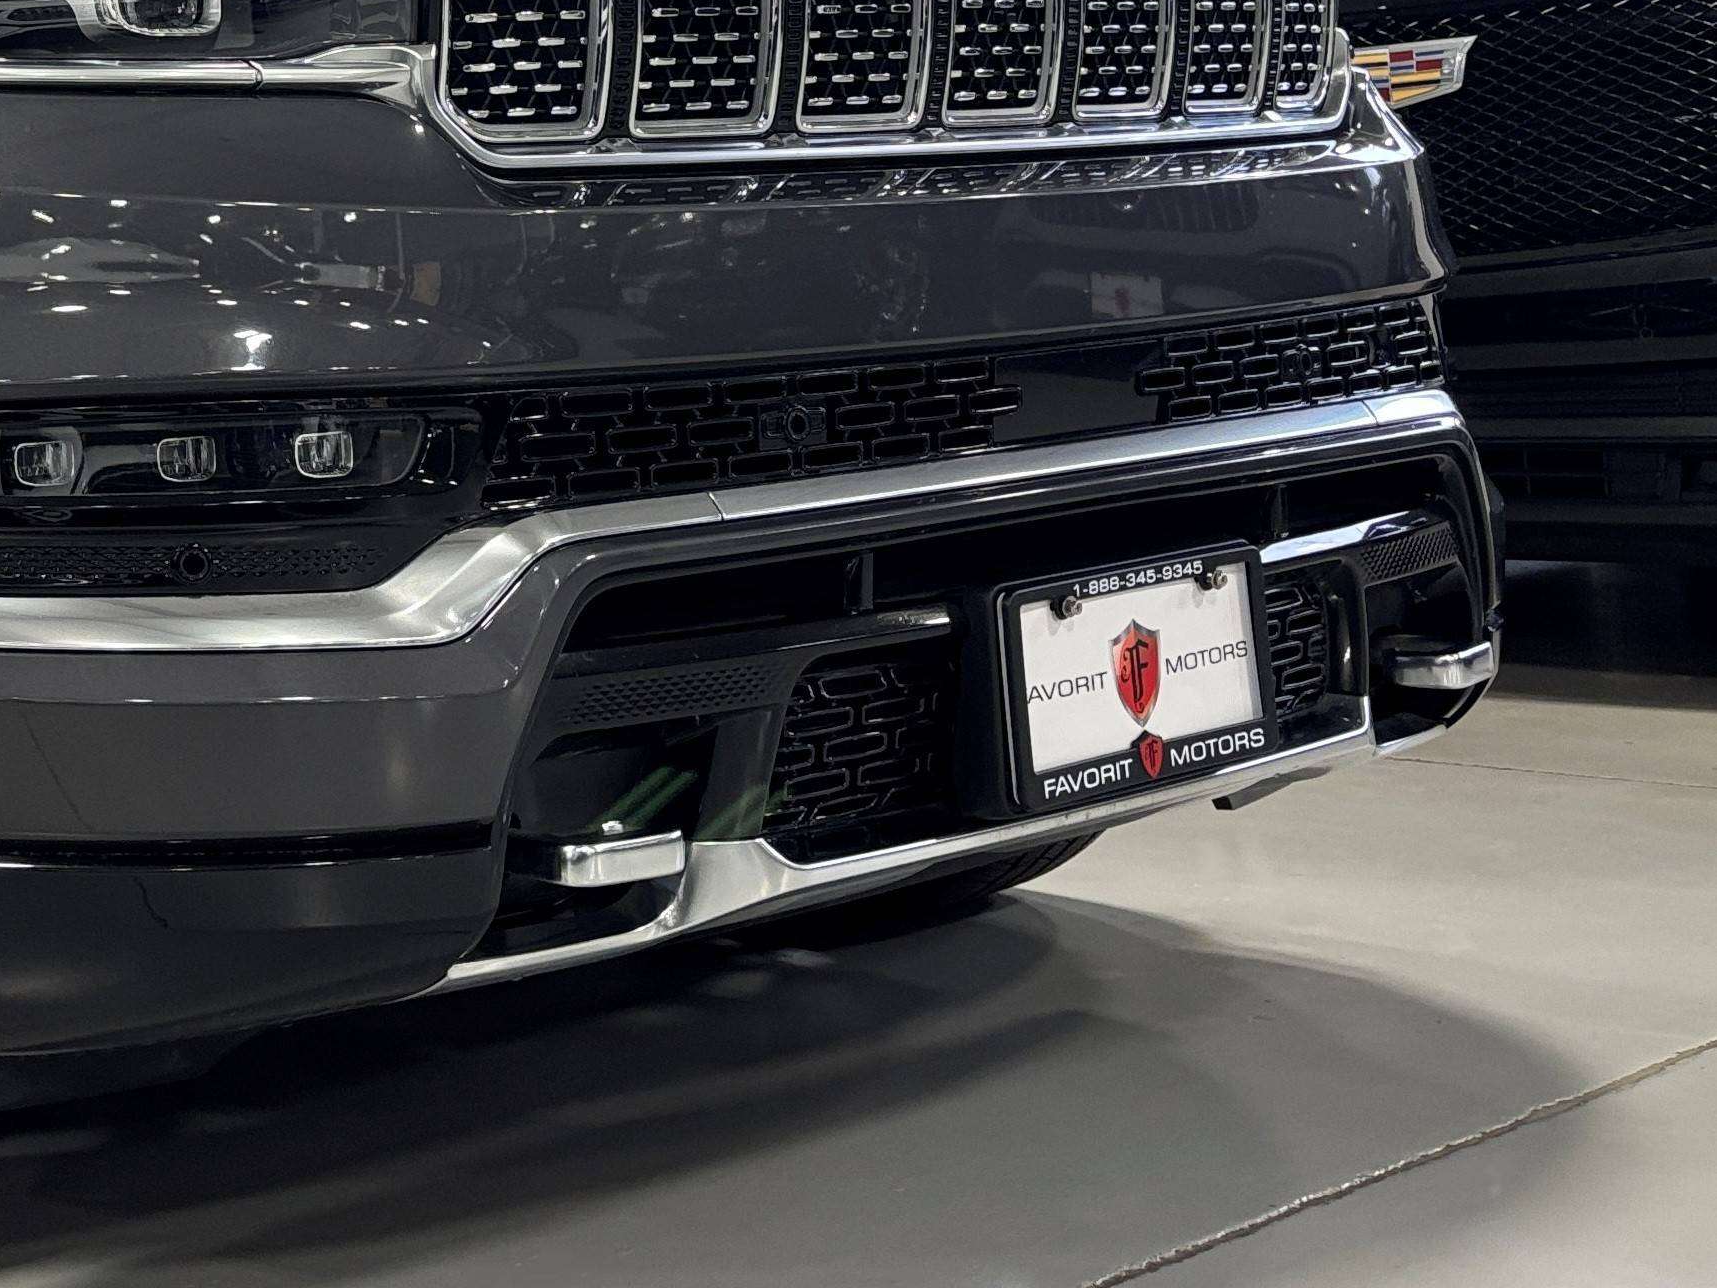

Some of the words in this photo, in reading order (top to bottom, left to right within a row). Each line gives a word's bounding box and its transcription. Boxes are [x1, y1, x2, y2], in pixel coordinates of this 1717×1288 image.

[1072, 560, 1204, 597] 1-888-345-9345
[1165, 640, 1249, 675] MOTORS
[1043, 758, 1134, 800] FAVORIT
[1170, 727, 1265, 768] MOTORS
